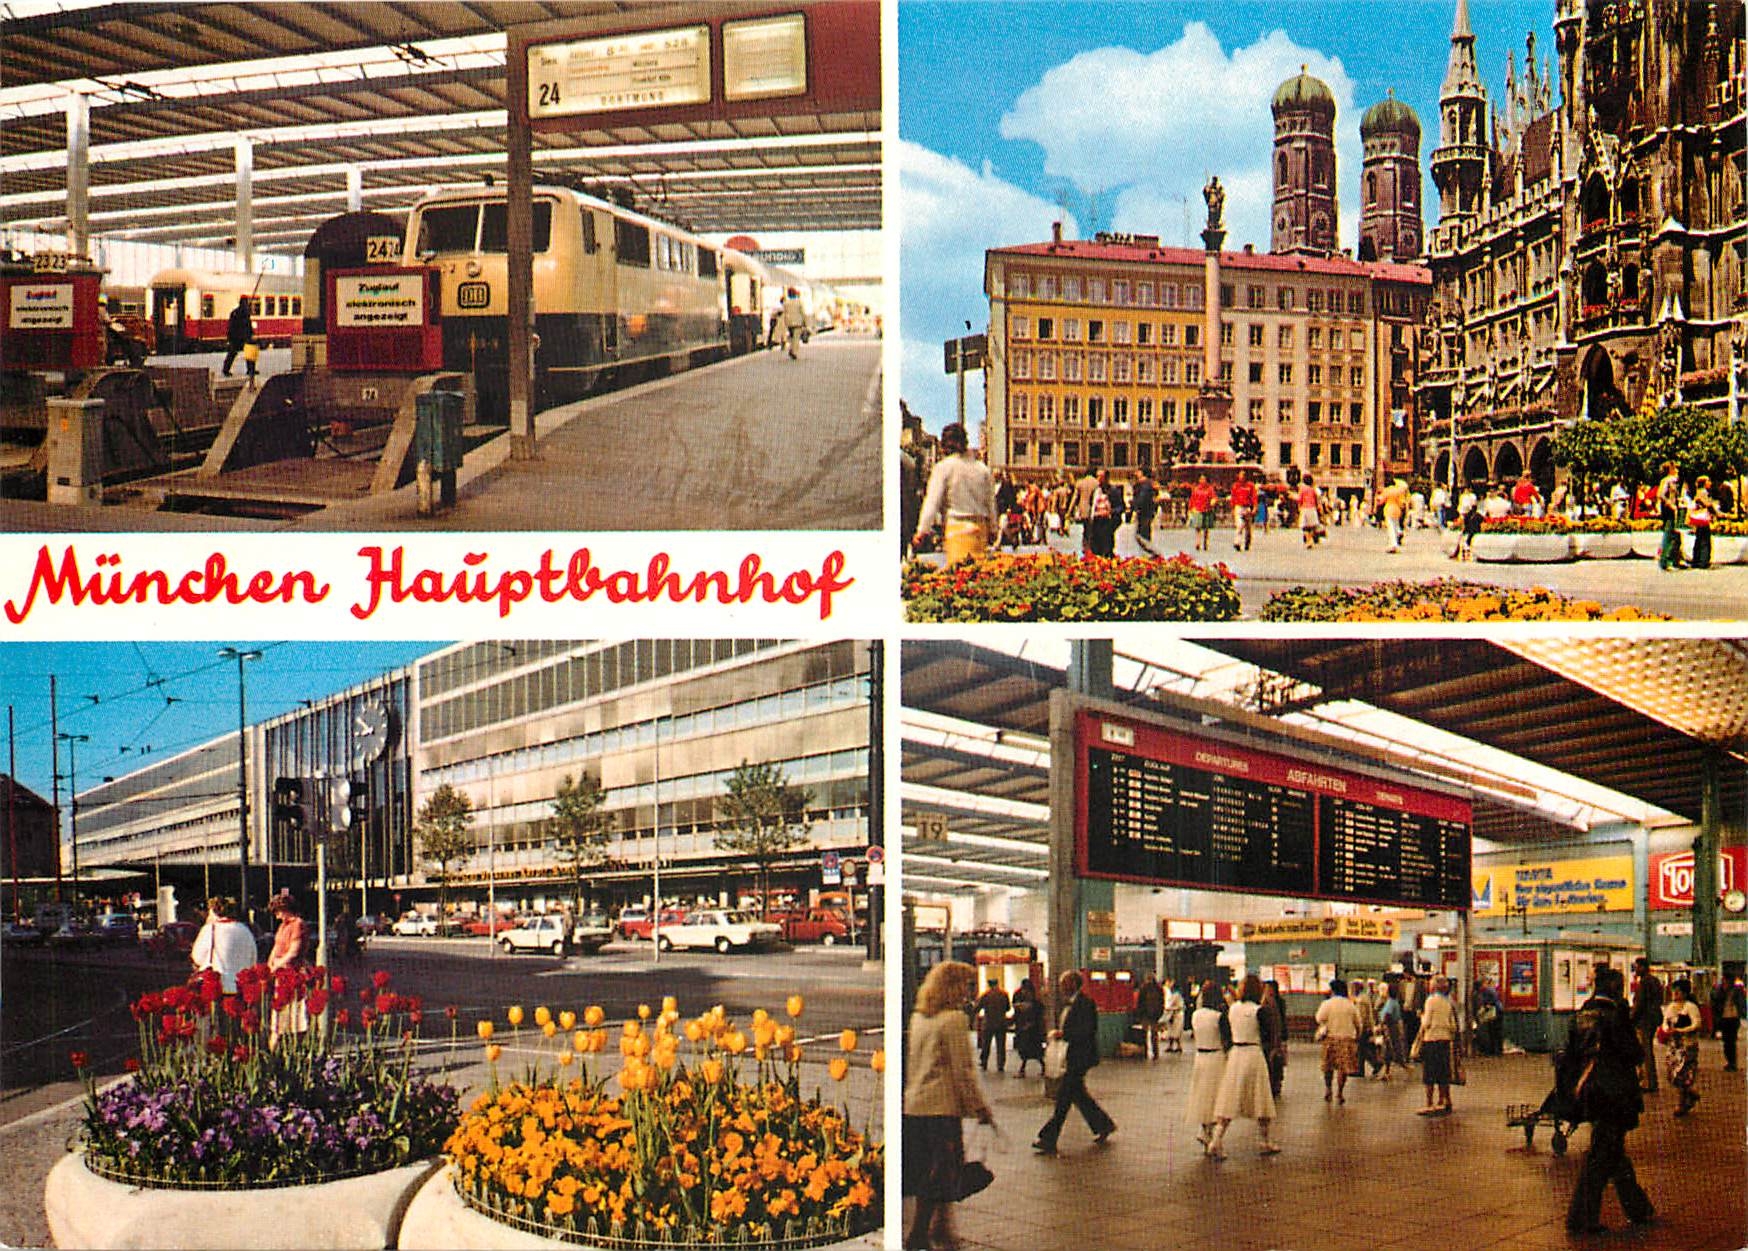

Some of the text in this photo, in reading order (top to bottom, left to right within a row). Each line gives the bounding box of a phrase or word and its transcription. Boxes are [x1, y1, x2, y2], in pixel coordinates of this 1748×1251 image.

[538, 81, 561, 106] 24
[368, 240, 388, 259] 24
[353, 311, 408, 322] angezeigt
[1286, 768, 1347, 793] ABFAHRTEN
[919, 821, 943, 840] 19
